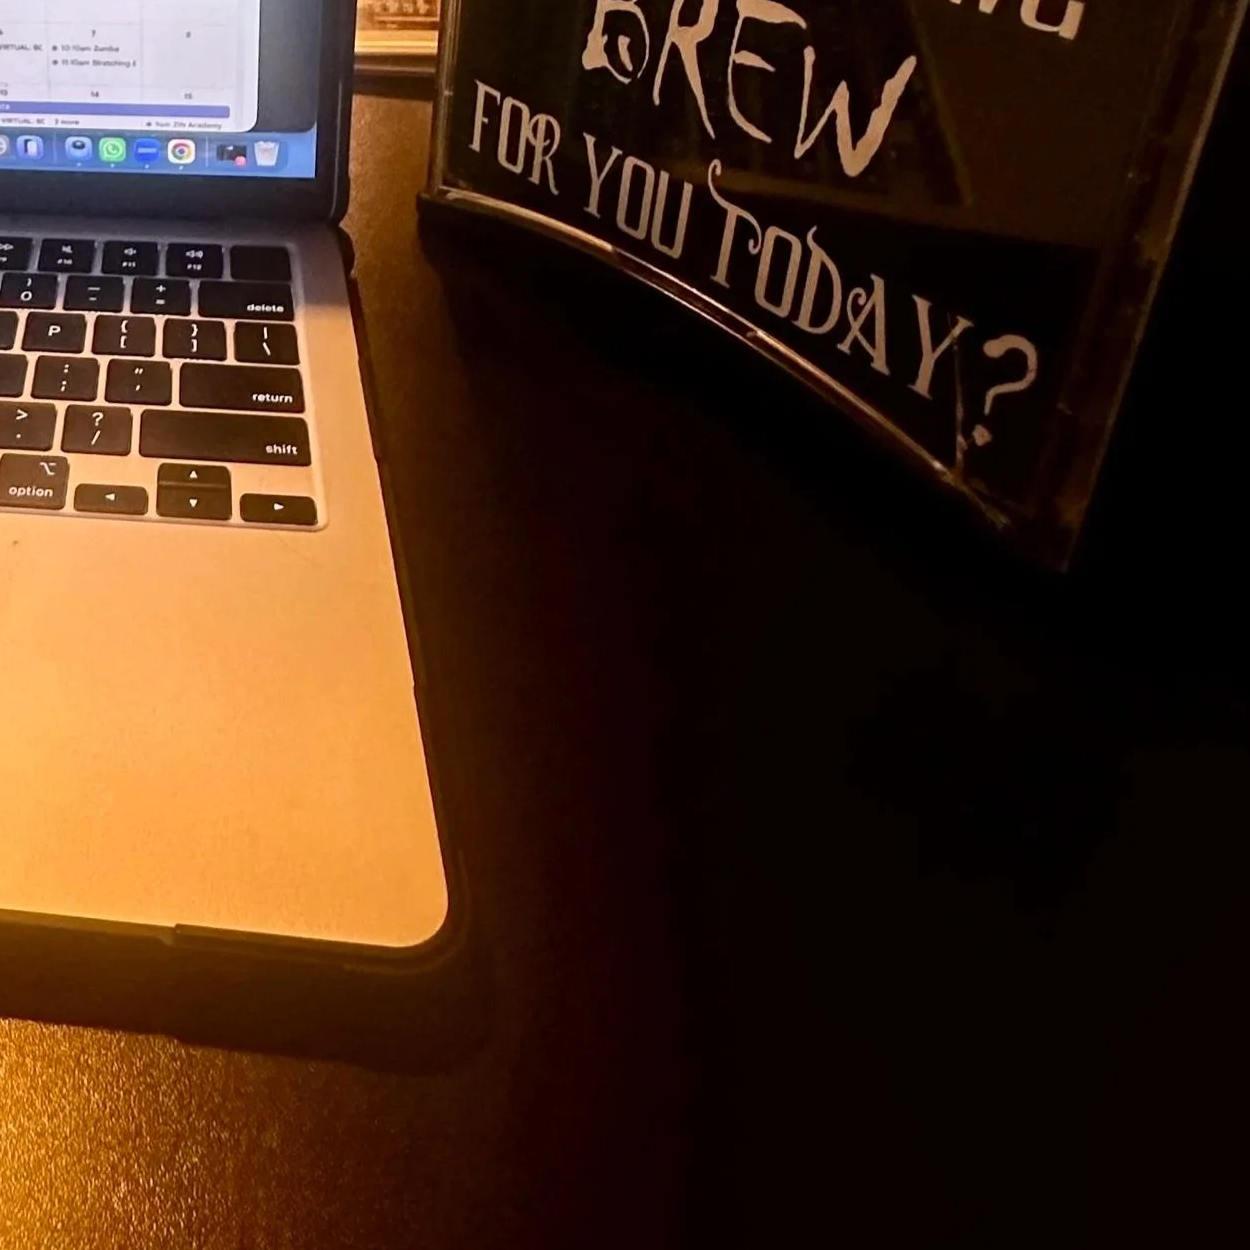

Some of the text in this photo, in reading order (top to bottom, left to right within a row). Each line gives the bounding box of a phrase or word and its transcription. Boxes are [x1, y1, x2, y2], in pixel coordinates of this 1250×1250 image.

[468, 80, 1040, 448] FOR YOU TODAY?
[247, 303, 285, 313] delete
[48, 325, 61, 336] P
[252, 393, 293, 403] return
[266, 443, 298, 455] shift
[8, 485, 53, 498] option
